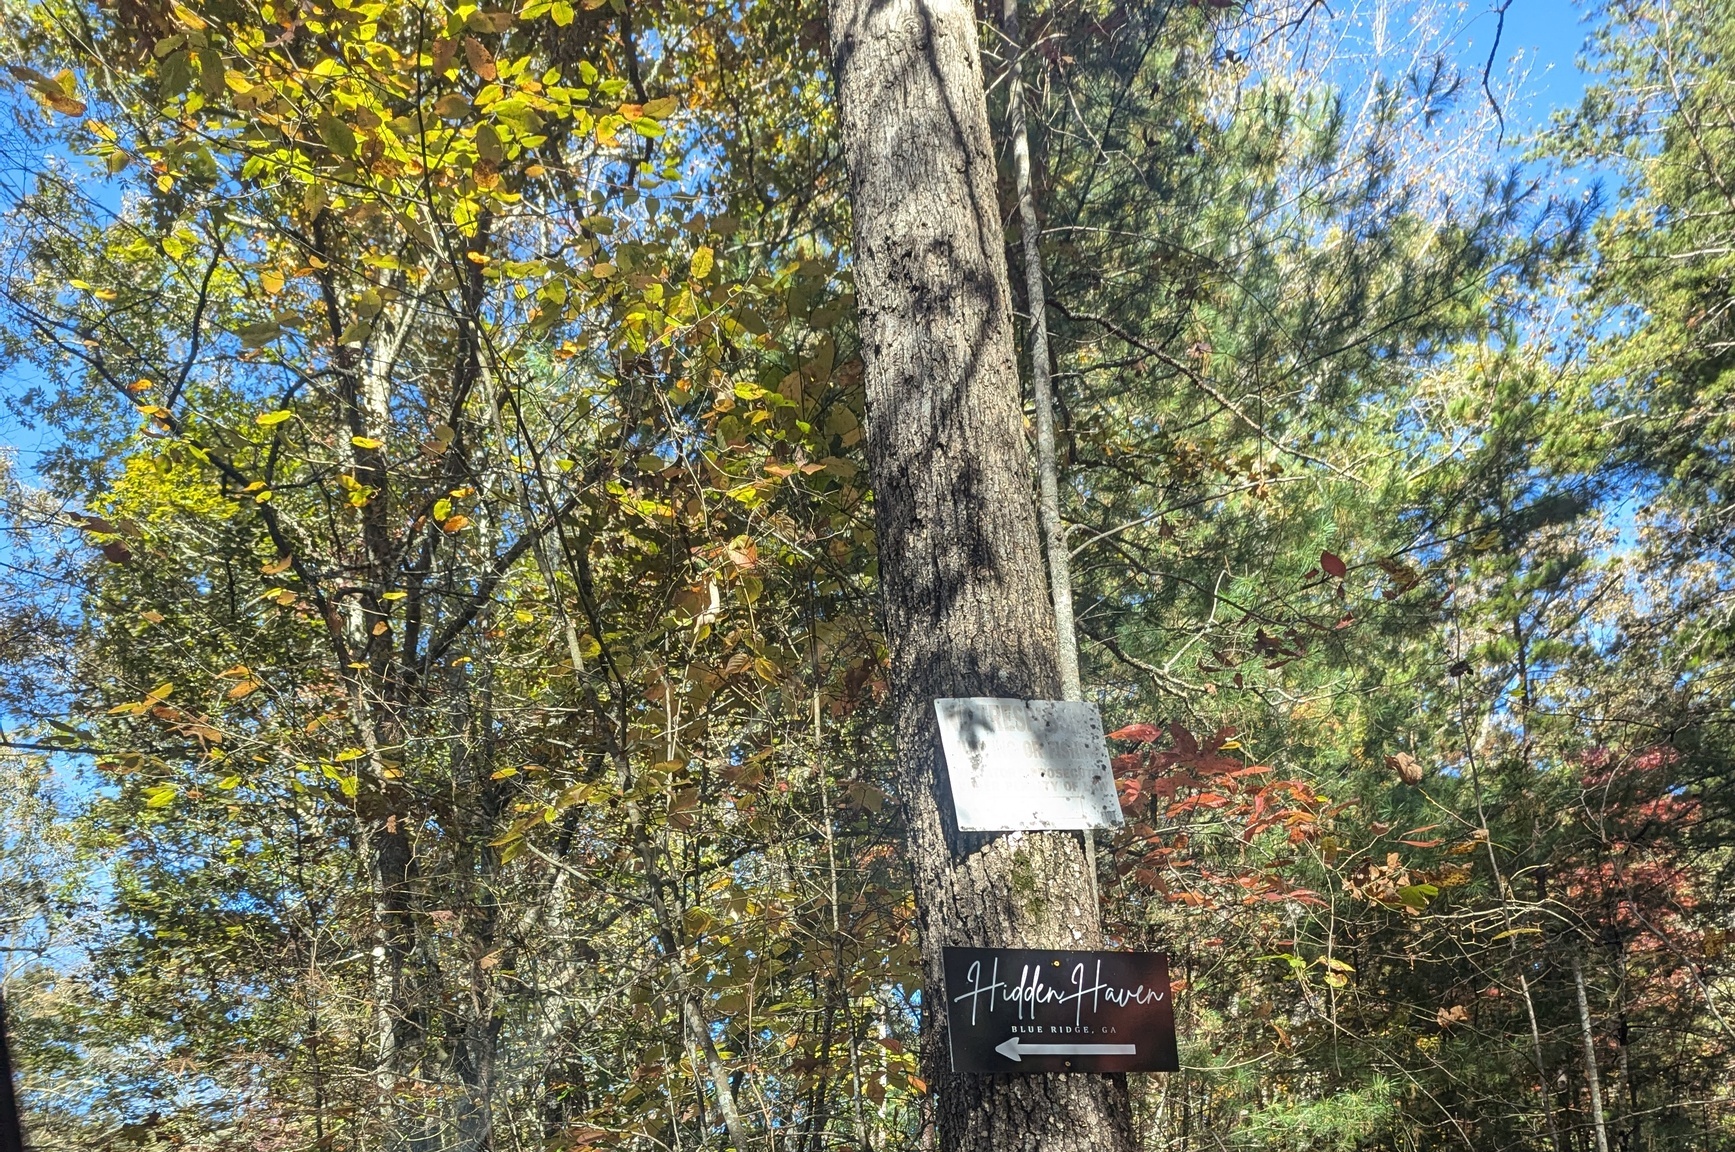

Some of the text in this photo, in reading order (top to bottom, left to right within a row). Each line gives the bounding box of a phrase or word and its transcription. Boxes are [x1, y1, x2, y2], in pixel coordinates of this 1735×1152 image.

[1063, 780, 1078, 792] OF
[954, 957, 1164, 1027] Hidden Haven
[1011, 1025, 1117, 1035] BLUE RIDGE, GA
